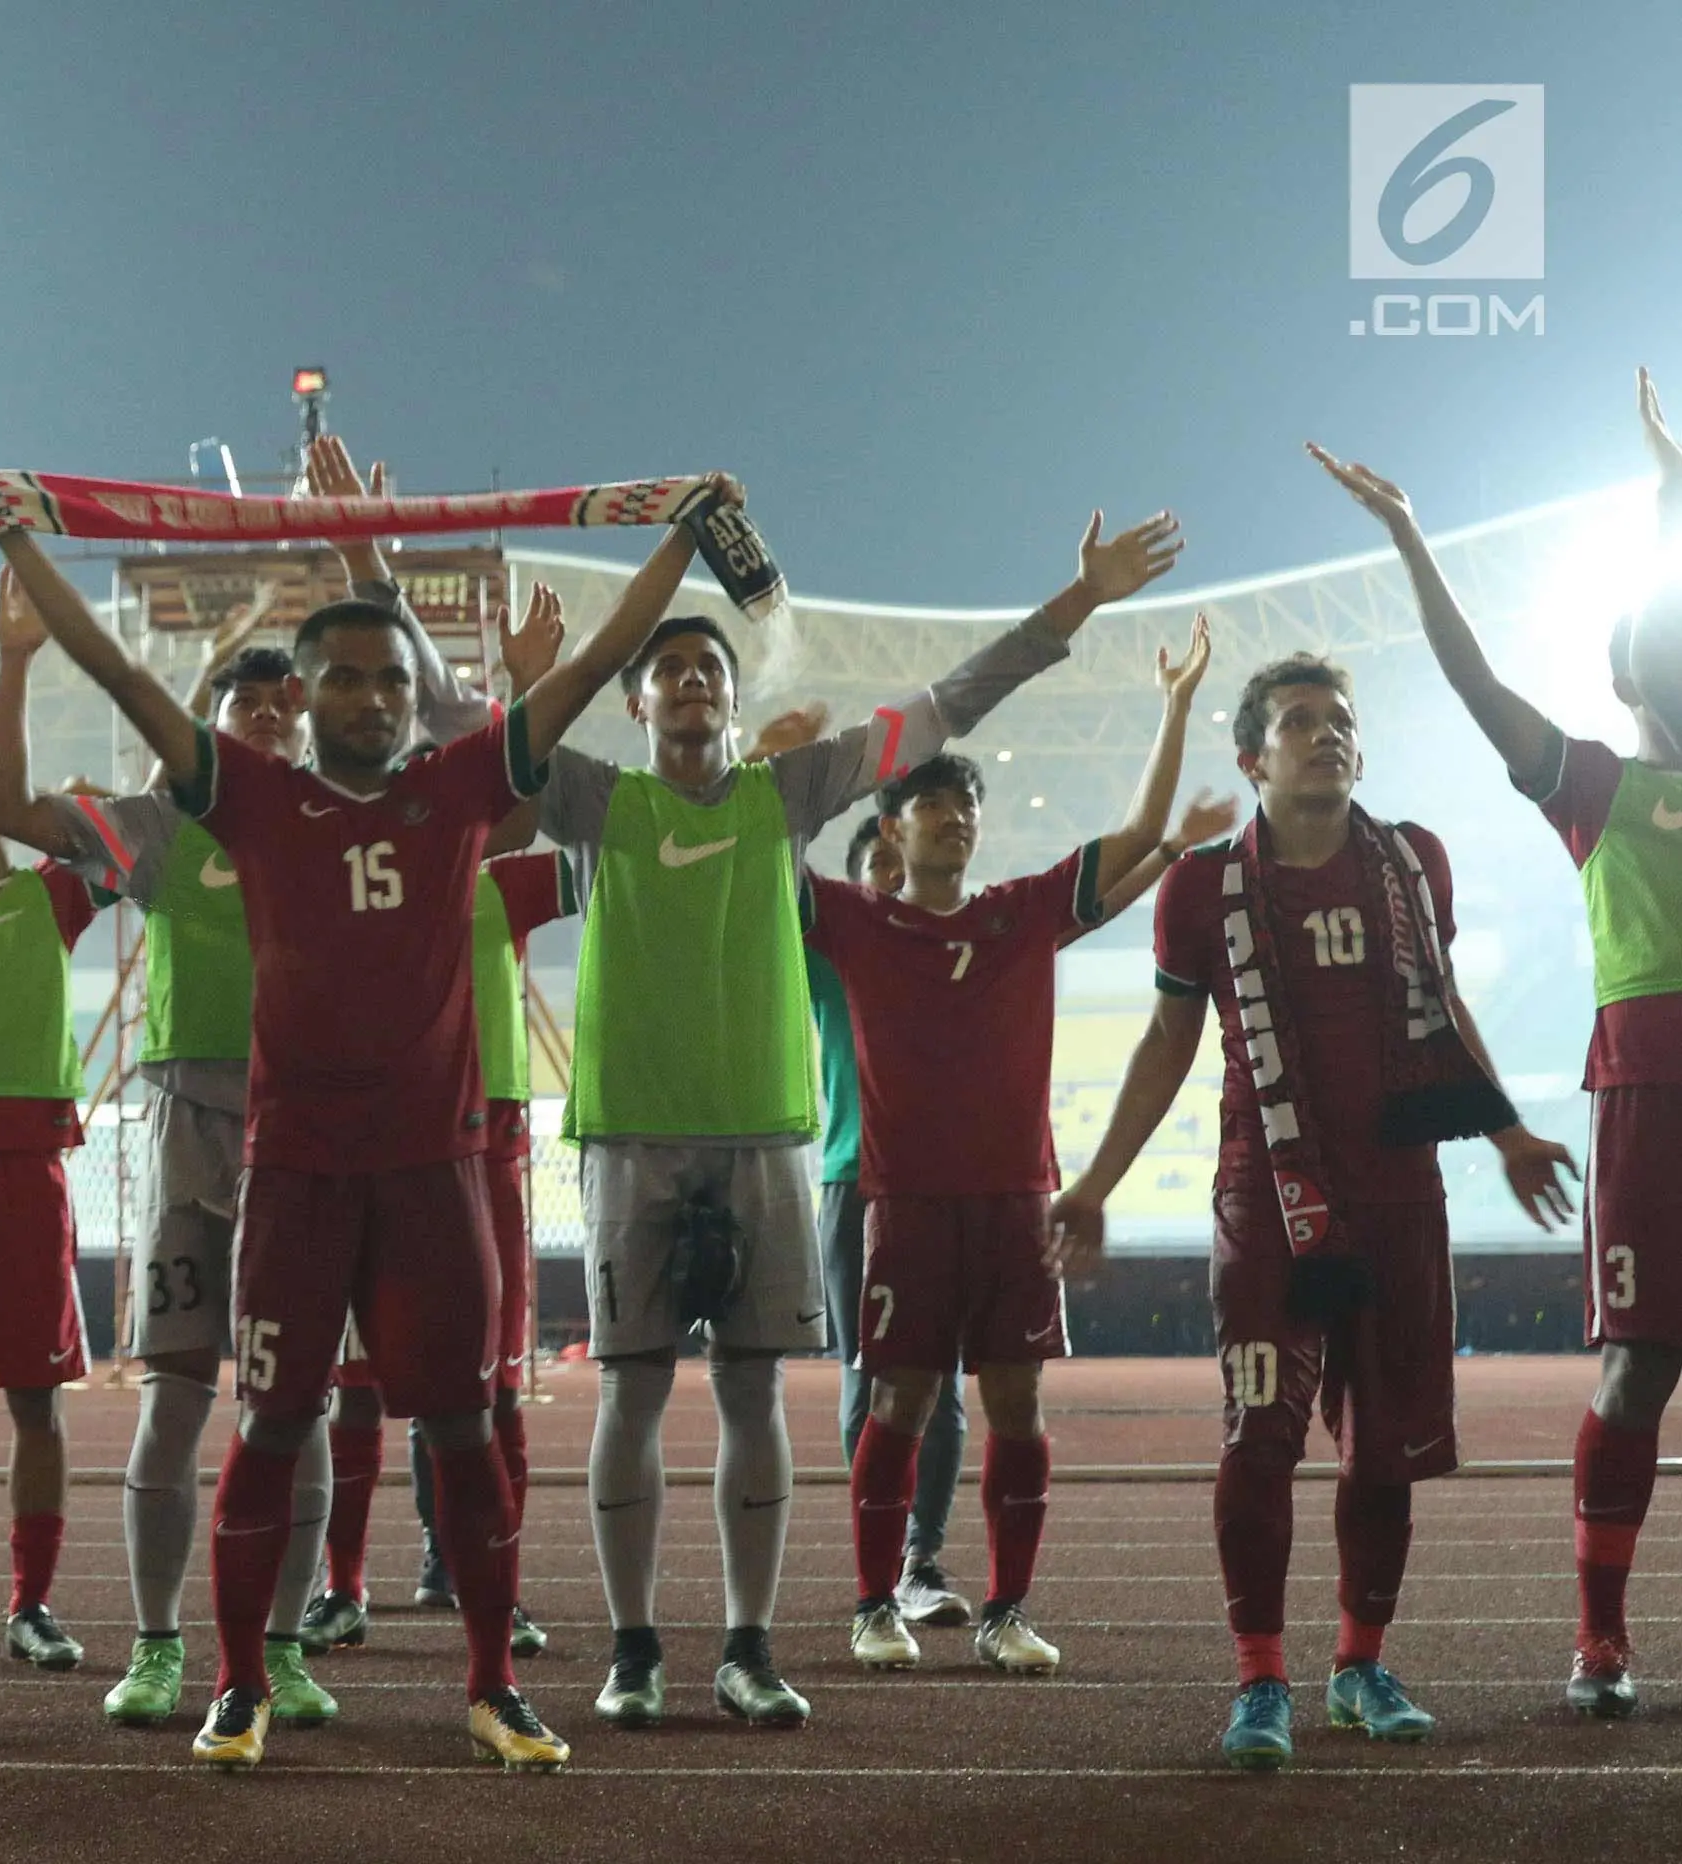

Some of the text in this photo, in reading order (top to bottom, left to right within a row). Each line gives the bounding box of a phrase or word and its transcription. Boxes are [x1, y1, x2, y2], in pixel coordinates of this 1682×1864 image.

[342, 840, 404, 911] 15
[945, 940, 974, 981] 7
[1302, 906, 1366, 967] 10
[1282, 1181, 1302, 1206] 9
[1294, 1218, 1314, 1242] 5
[146, 1256, 201, 1316] 33
[1604, 1244, 1636, 1309] 3
[869, 1284, 895, 1340] 7
[237, 1314, 281, 1391] 15
[1224, 1340, 1278, 1409] 10
